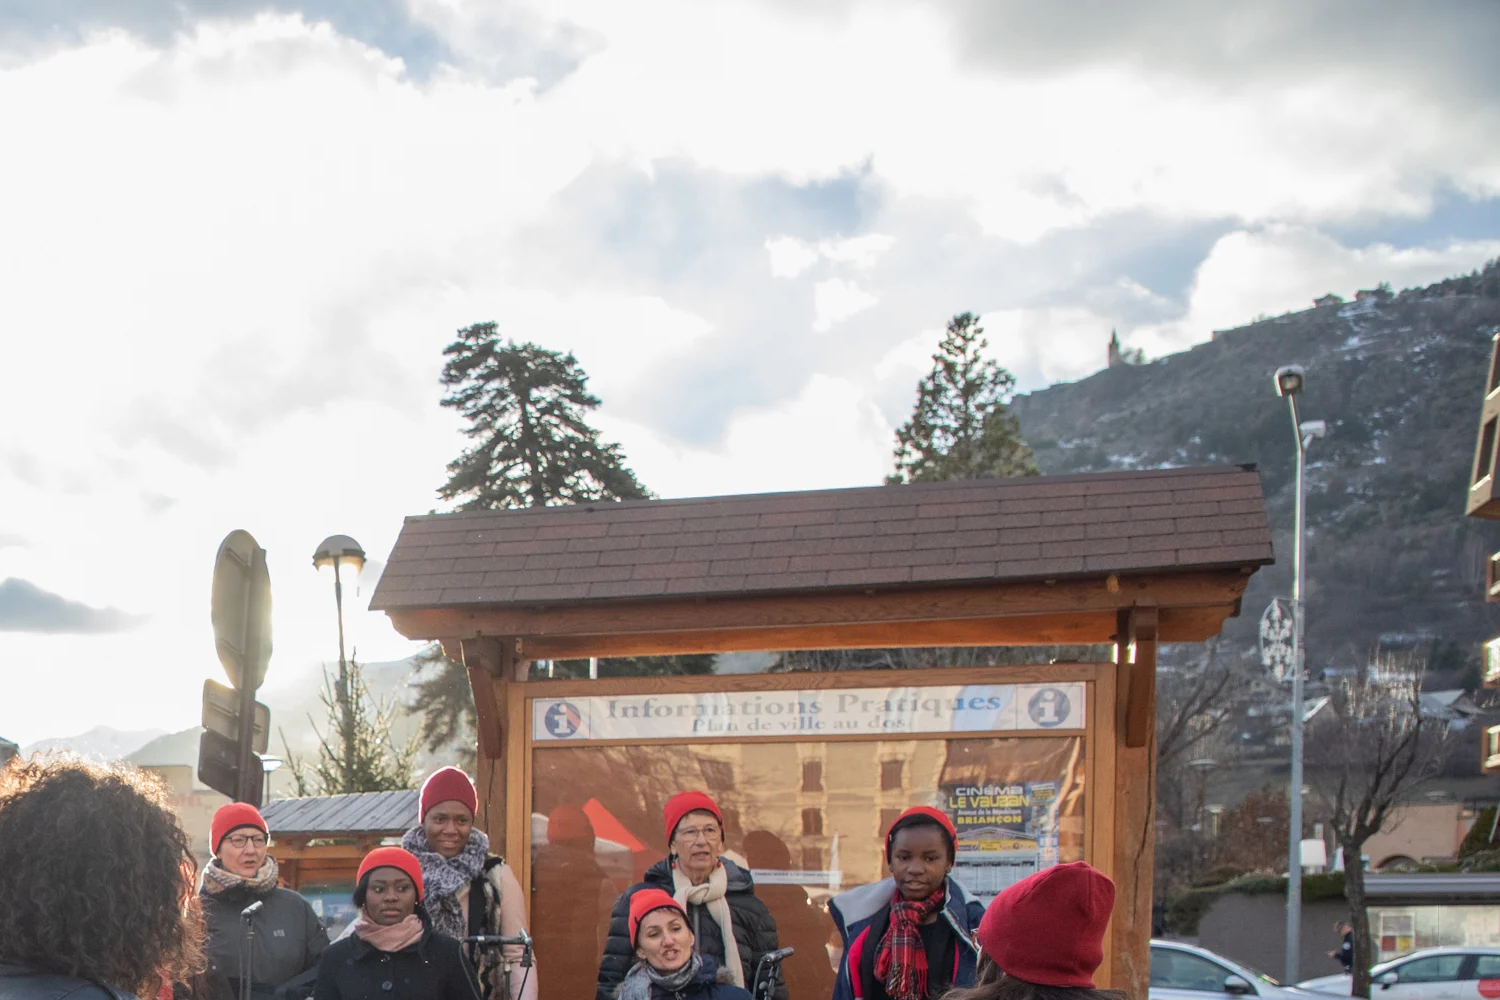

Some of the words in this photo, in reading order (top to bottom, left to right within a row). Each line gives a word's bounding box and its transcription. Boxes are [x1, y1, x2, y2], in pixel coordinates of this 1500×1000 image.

[605, 696, 823, 720] Informations
[837, 691, 1001, 718] Pratiques
[691, 718, 739, 732] Plan
[747, 718, 772, 732] de
[780, 716, 826, 731] ville
[833, 718, 858, 730] au
[868, 715, 905, 730] dos
[949, 796, 967, 809] LE
[957, 815, 1022, 825] BRIANÇON
